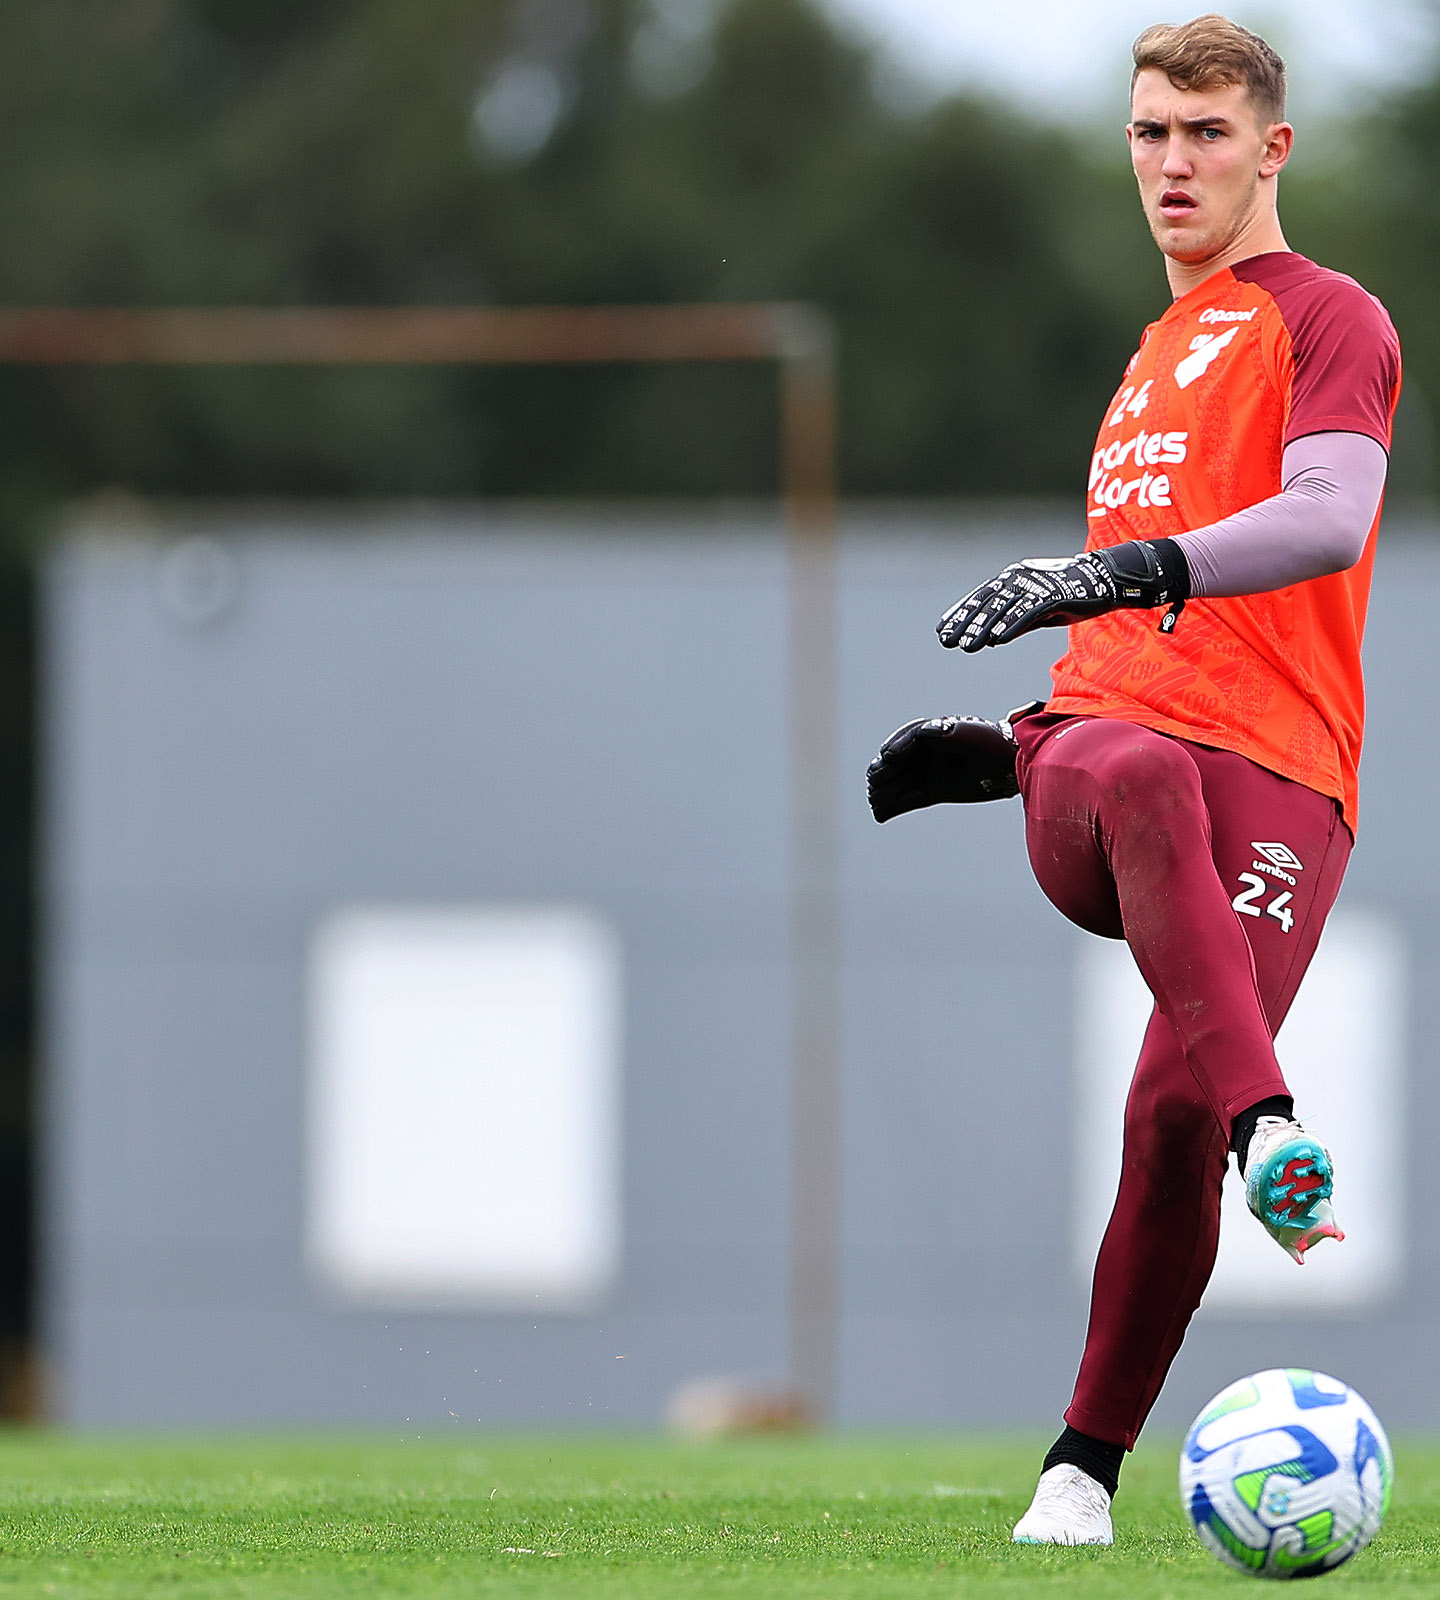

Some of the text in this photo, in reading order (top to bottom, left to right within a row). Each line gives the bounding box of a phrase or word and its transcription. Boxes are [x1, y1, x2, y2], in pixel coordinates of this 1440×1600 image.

[1108, 379, 1154, 427] 24
[1012, 574, 1049, 600] CHANGE
[1252, 860, 1297, 886] umbro
[1232, 871, 1295, 934] 24
